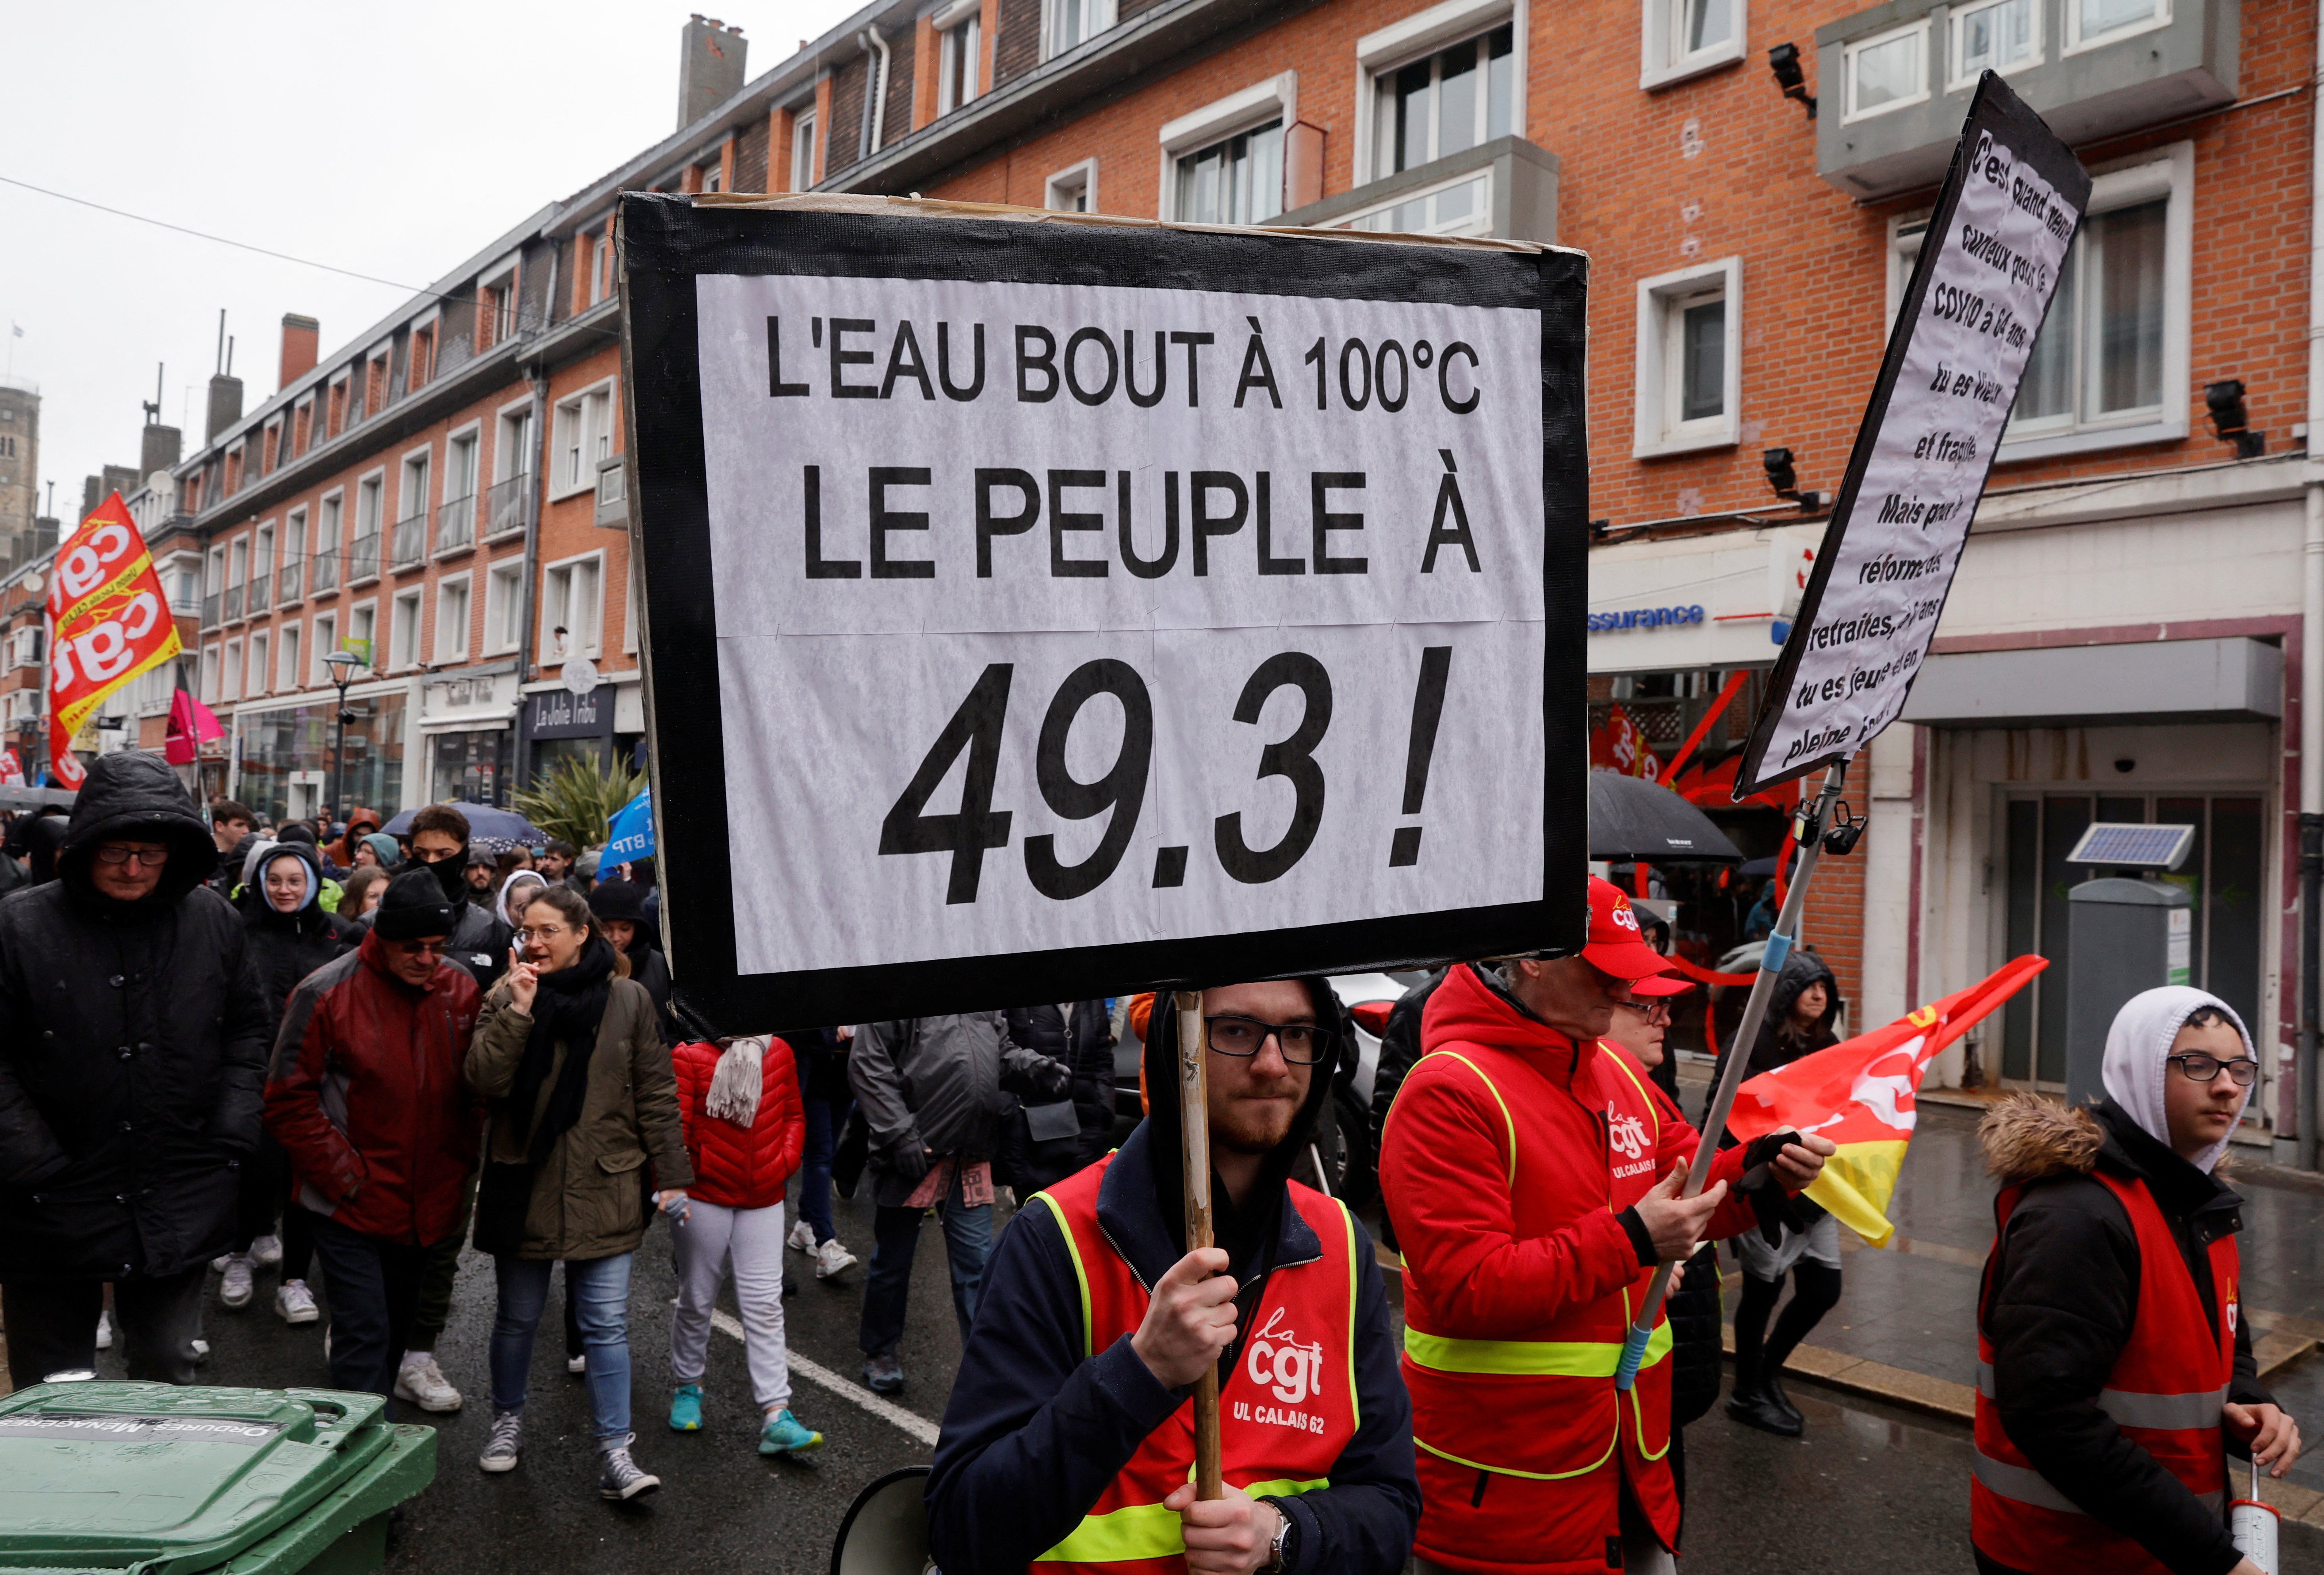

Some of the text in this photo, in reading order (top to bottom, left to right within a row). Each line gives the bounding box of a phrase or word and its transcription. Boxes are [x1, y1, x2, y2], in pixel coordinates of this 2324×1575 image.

[1972, 137, 2010, 193] C'est
[2011, 176, 2050, 220] quand
[1962, 224, 2012, 273] curieux
[2012, 255, 2035, 287] pour
[1979, 302, 1995, 333] à
[767, 316, 1480, 415] L'EAU BOUT À 100°C
[1930, 361, 1951, 392] tu
[1953, 373, 1973, 396] es
[1914, 432, 1976, 469] et fragile
[804, 449, 1482, 579] LE PEUPLE À
[1877, 494, 1925, 524] Mais
[1587, 605, 1704, 631] ssurance
[1809, 612, 1896, 651] retraites,
[1796, 681, 1819, 709] tu
[1822, 676, 1846, 701] es
[1903, 648, 1918, 670] en
[534, 696, 547, 733] La
[1782, 725, 1851, 768] pleine
[878, 646, 1452, 905] 49.3 !
[1612, 895, 1632, 911] la
[1612, 909, 1639, 931] cgt
[1608, 1100, 1630, 1123] la
[1610, 1116, 1651, 1159] cgt
[1612, 1166, 1626, 1179] UL
[1625, 1160, 1652, 1176] CALAIS
[1255, 1306, 1308, 1348] la
[1247, 1340, 1323, 1404] cgt
[1233, 1401, 1324, 1435] UL CALAIS 62
